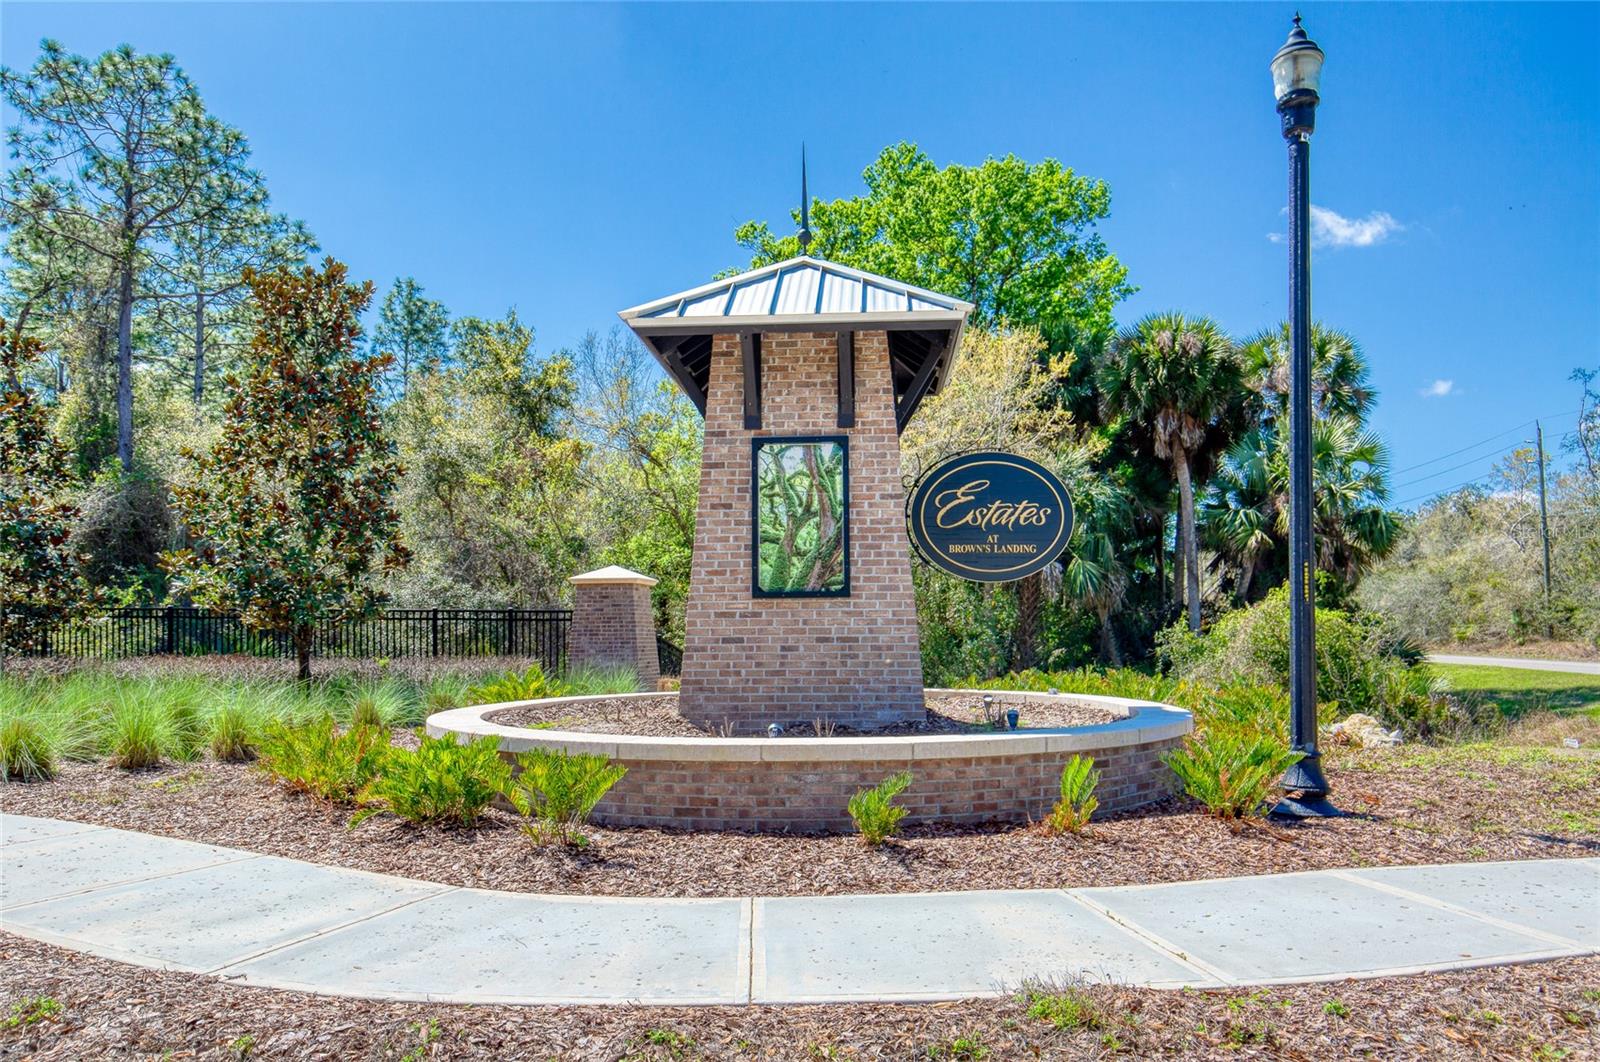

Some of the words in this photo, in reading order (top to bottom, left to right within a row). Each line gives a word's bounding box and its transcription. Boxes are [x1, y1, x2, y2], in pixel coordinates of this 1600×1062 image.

[935, 480, 1051, 531] Estates
[987, 534, 999, 543] AT
[949, 544, 991, 553] BROWN'S
[994, 544, 1037, 553] LANDING
